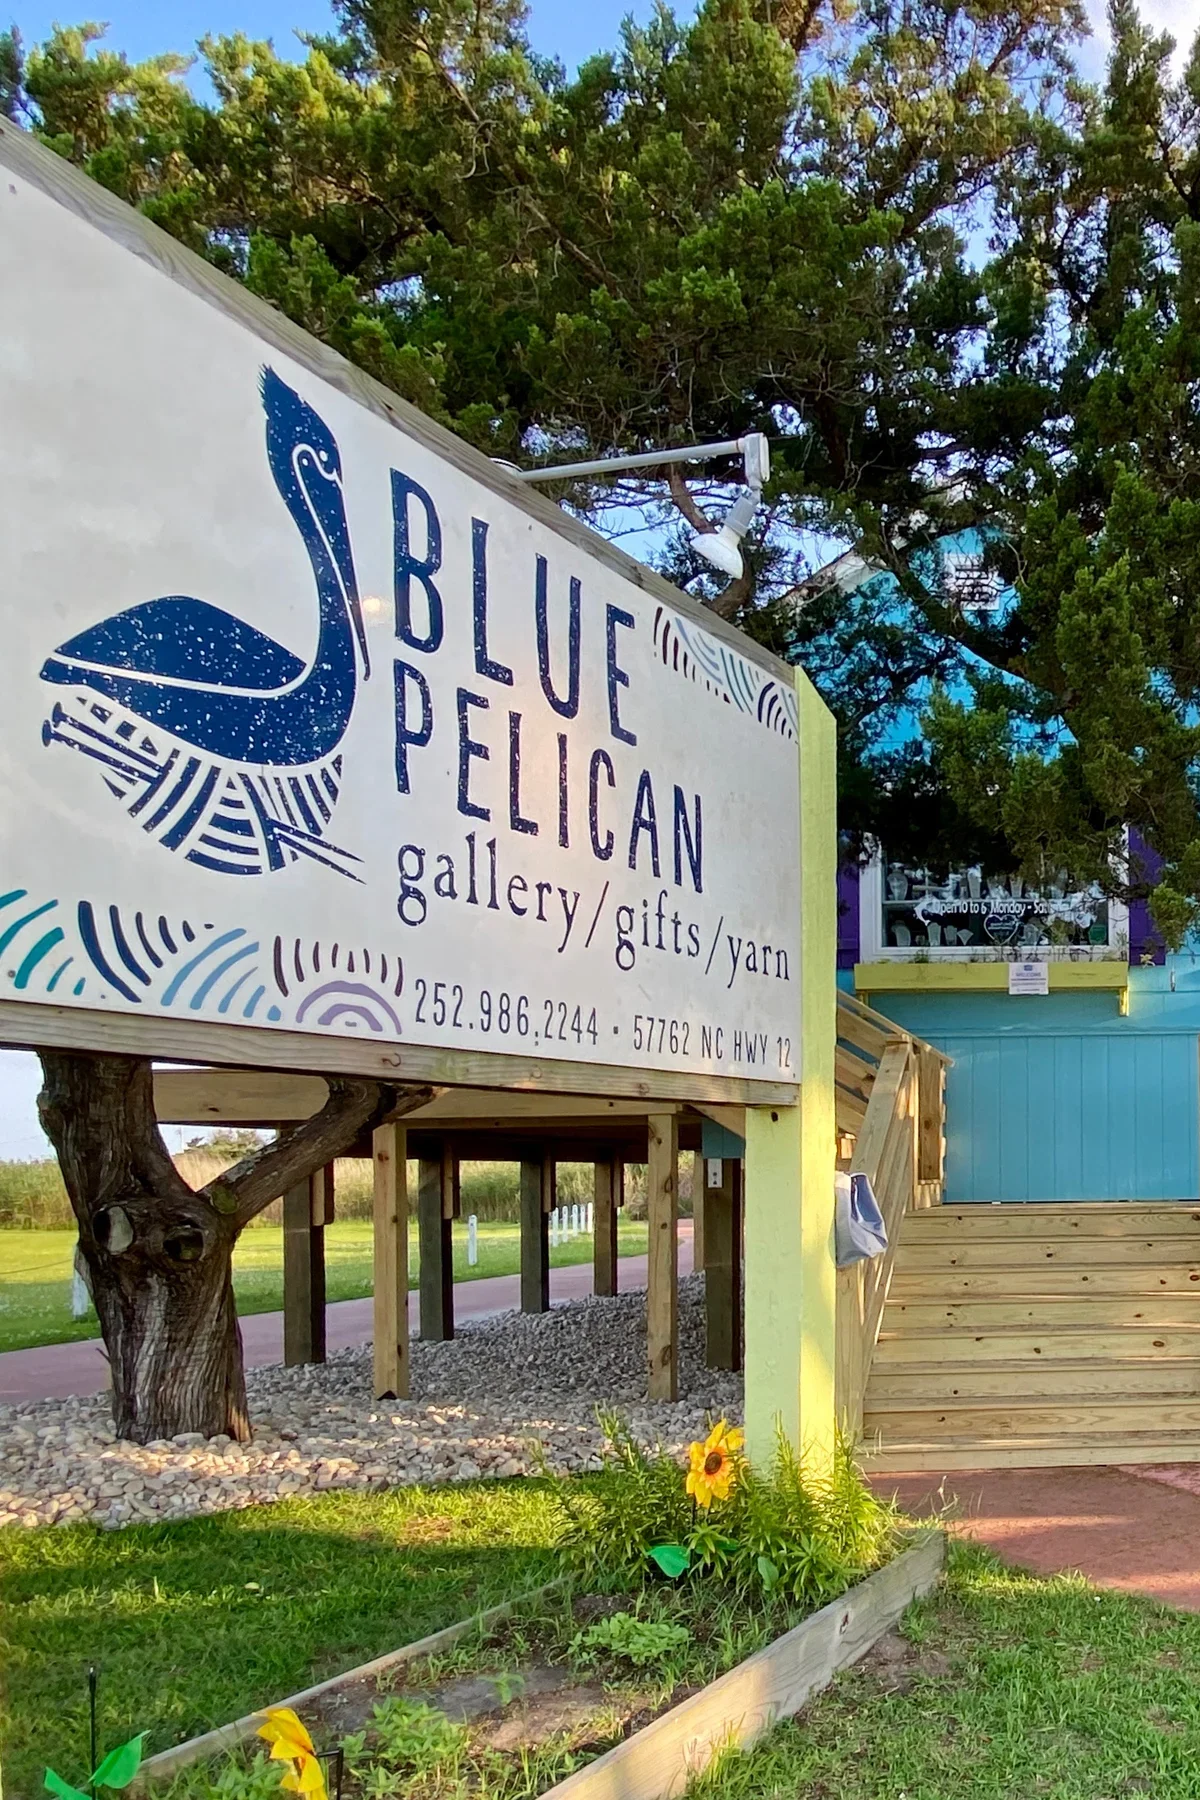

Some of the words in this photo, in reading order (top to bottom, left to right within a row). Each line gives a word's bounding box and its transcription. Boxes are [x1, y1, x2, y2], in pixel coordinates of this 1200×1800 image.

[390, 467, 637, 746] BLUE
[393, 658, 703, 893] PELICAN
[397, 831, 790, 989] gallery/gifts/yarn
[970, 900, 980, 914] to
[981, 902, 987, 915] 6
[990, 900, 1026, 917] Monday
[633, 1015, 691, 1056] 57762
[701, 1024, 724, 1060] NC
[733, 1029, 769, 1065] HWY
[777, 1037, 792, 1068] 12
